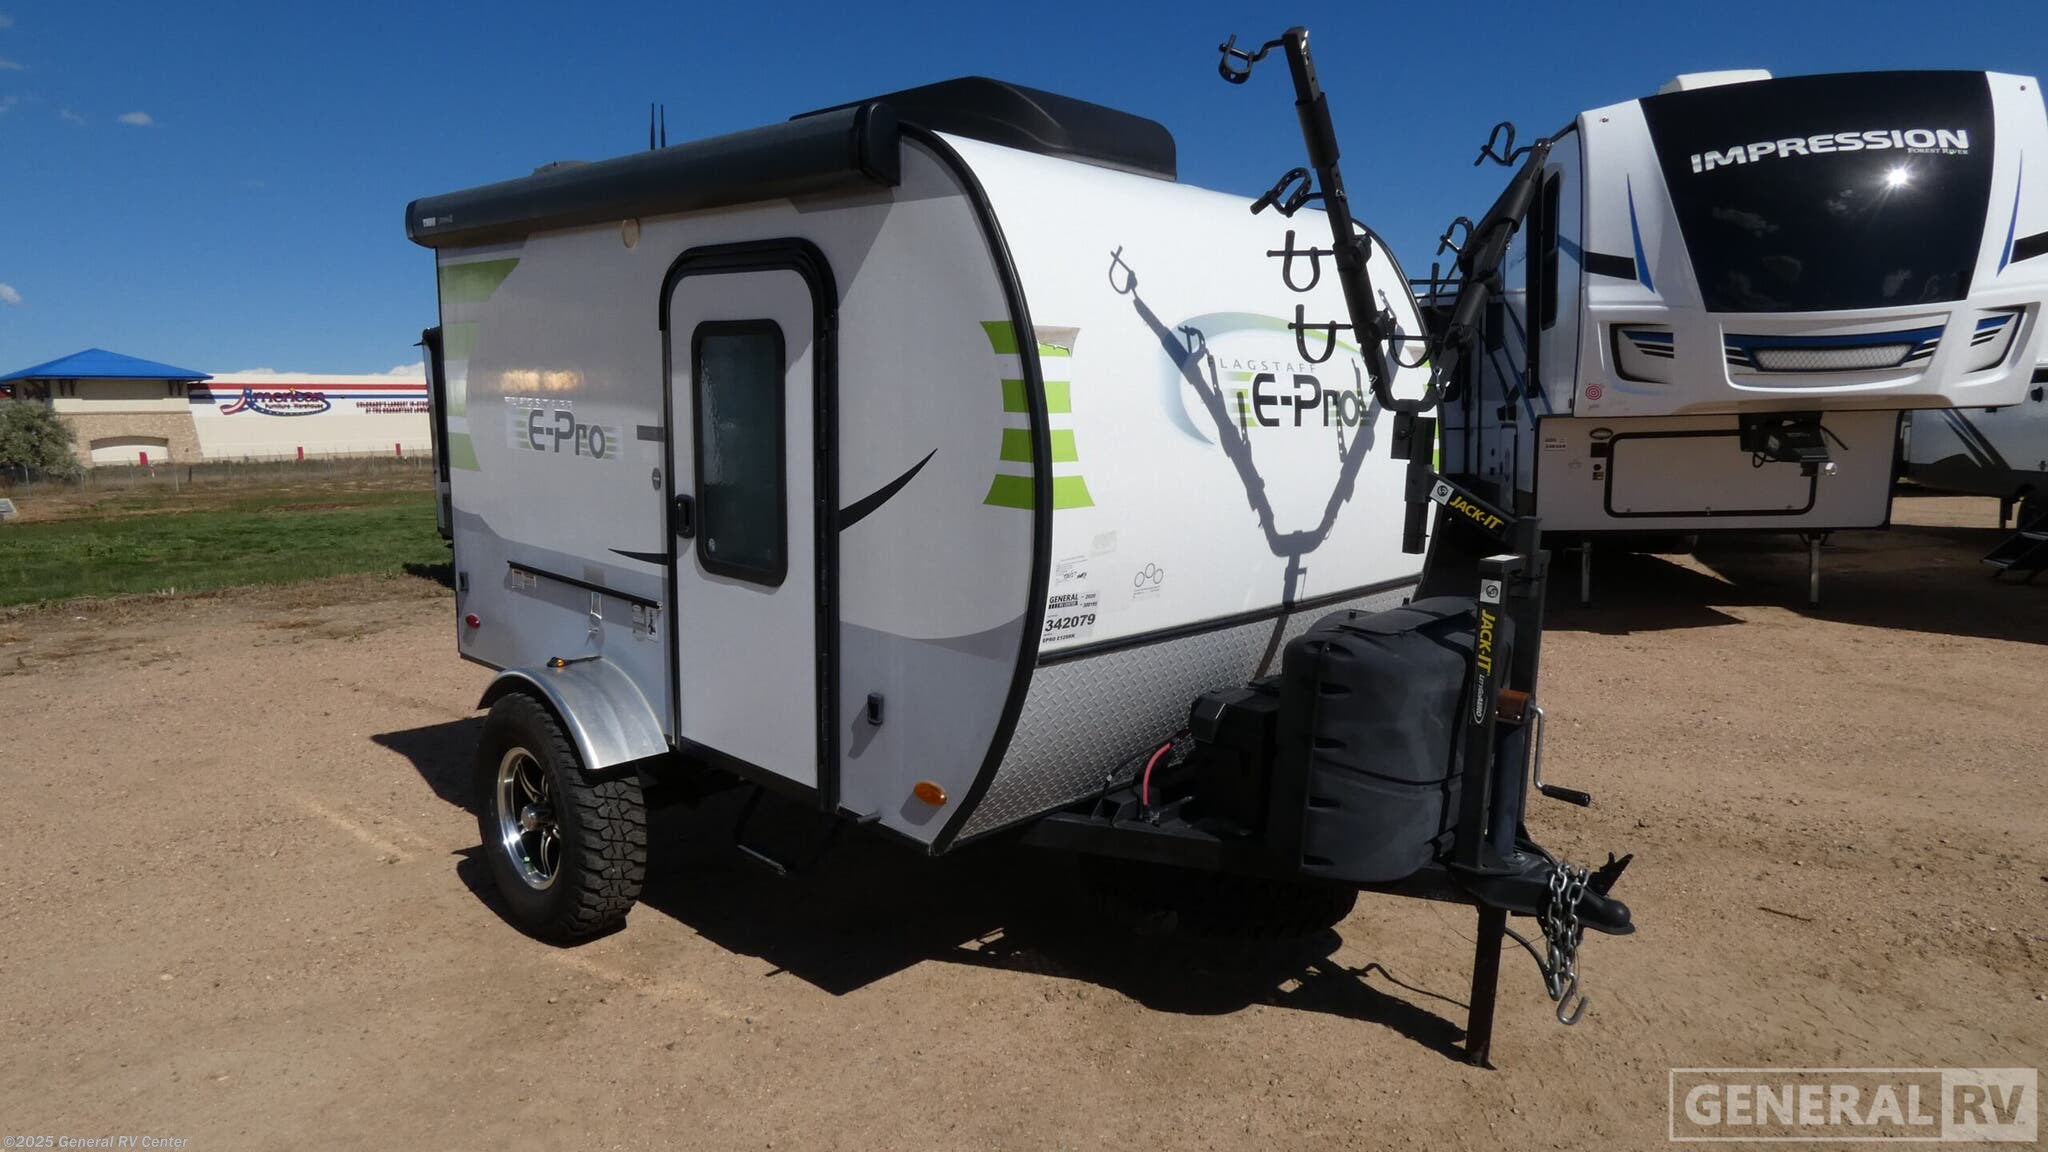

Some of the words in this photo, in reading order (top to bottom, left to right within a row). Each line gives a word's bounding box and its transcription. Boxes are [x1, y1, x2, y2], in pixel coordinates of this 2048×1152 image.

[1691, 129, 1969, 173] IMPRESSION
[1252, 373, 1361, 427] E-Pro
[529, 409, 606, 459] E-Pro
[1449, 496, 1505, 529] JACK-IT
[1049, 593, 1078, 603] GENERAL
[1045, 613, 1096, 632] 342079
[1477, 609, 1496, 676] JACK-IT
